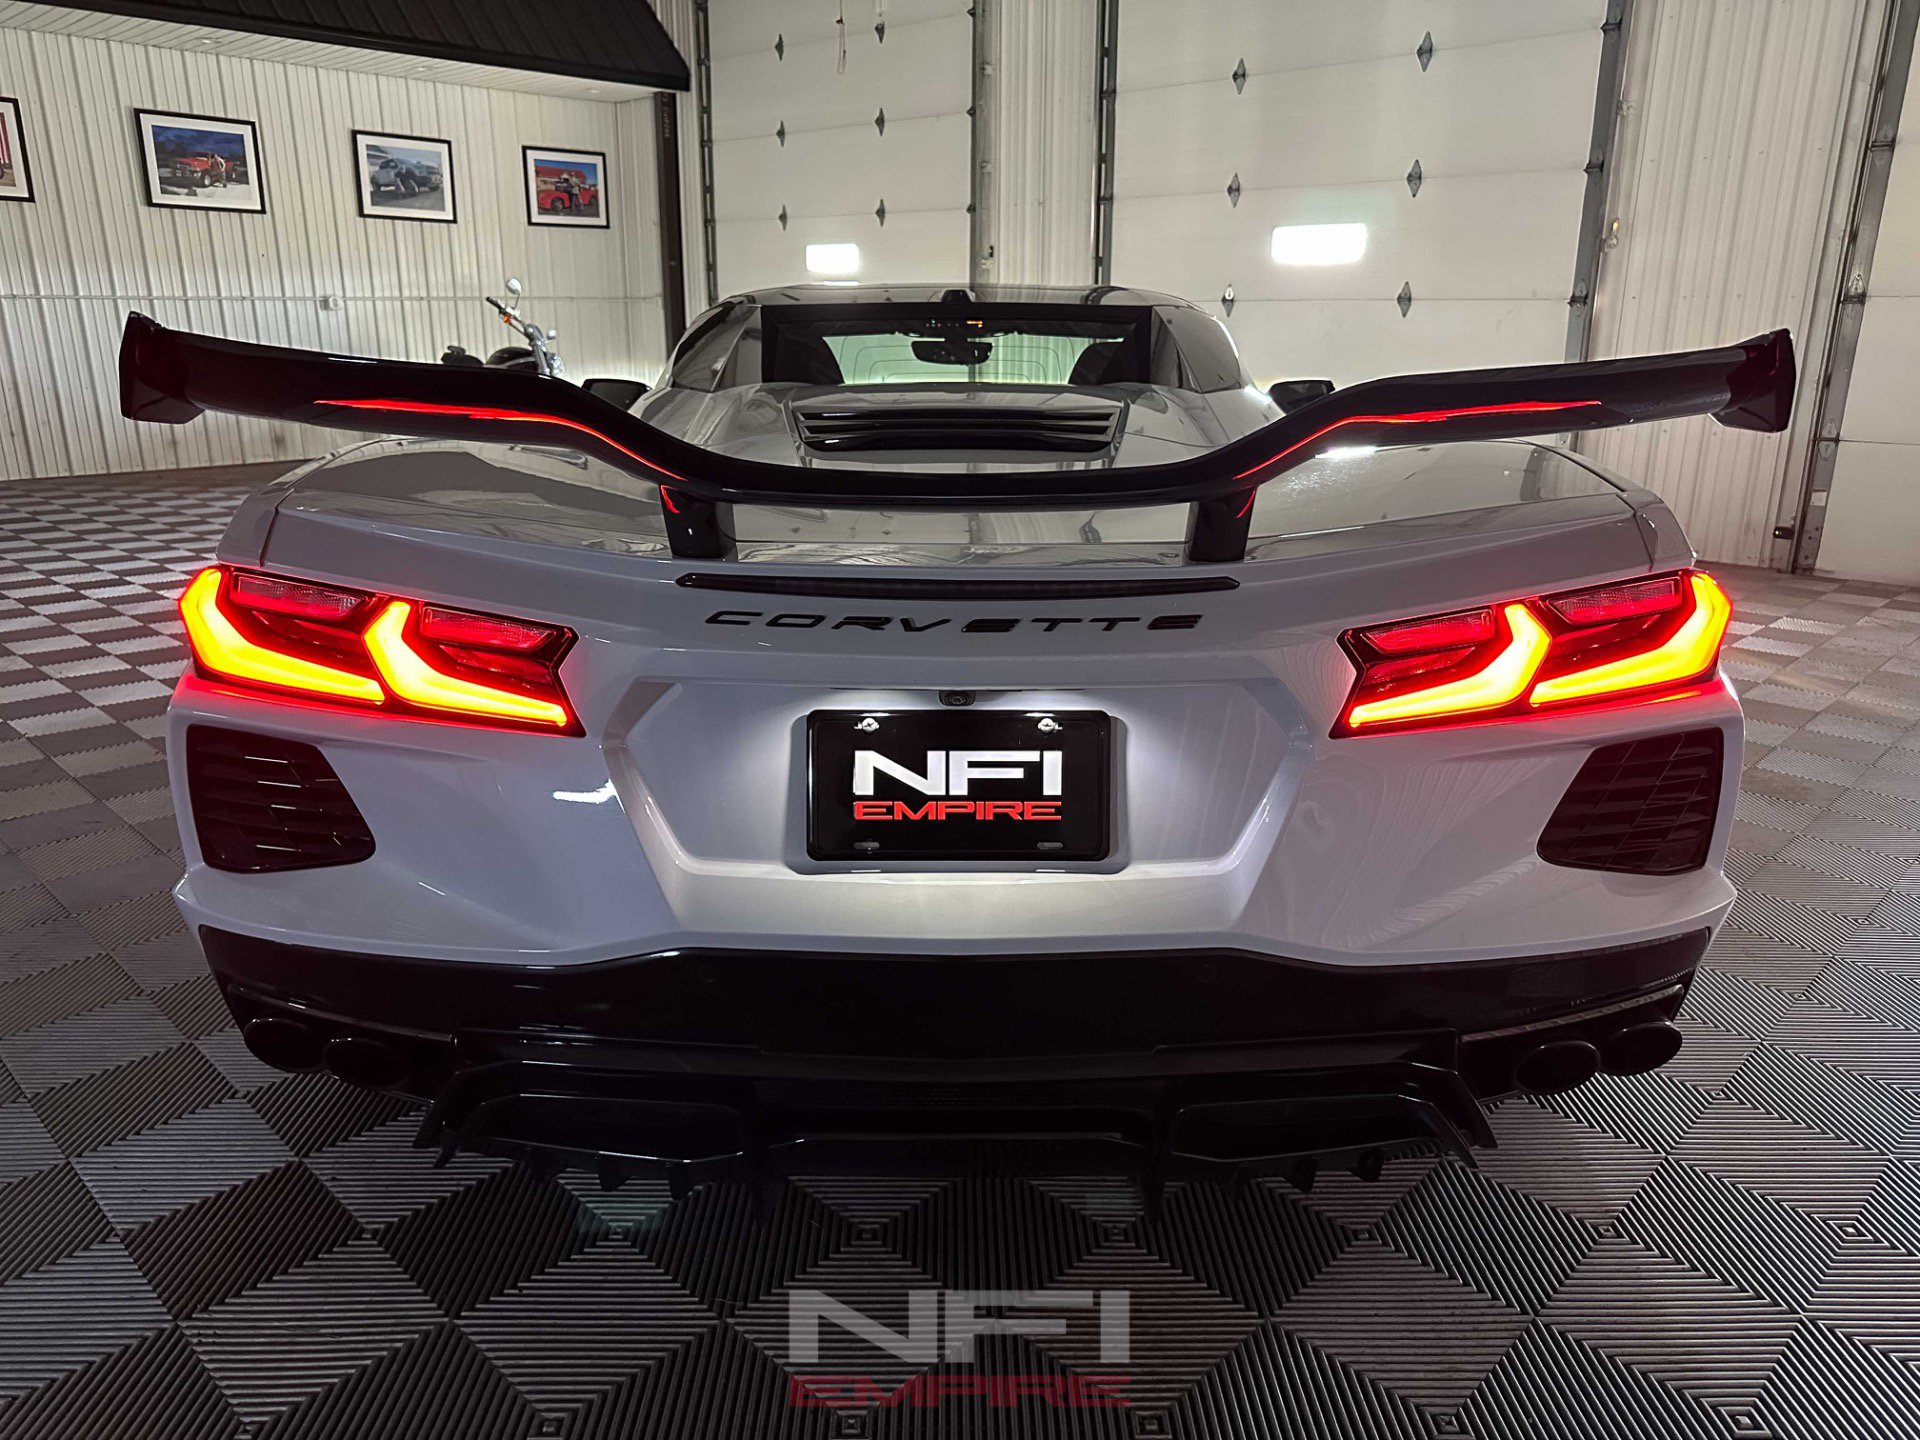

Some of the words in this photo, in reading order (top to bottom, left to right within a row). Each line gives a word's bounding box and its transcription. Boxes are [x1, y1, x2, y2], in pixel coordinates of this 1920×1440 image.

[705, 611, 1202, 632] CORVETTE
[853, 750, 1063, 796] NFI
[853, 801, 1063, 821] EMPIRE
